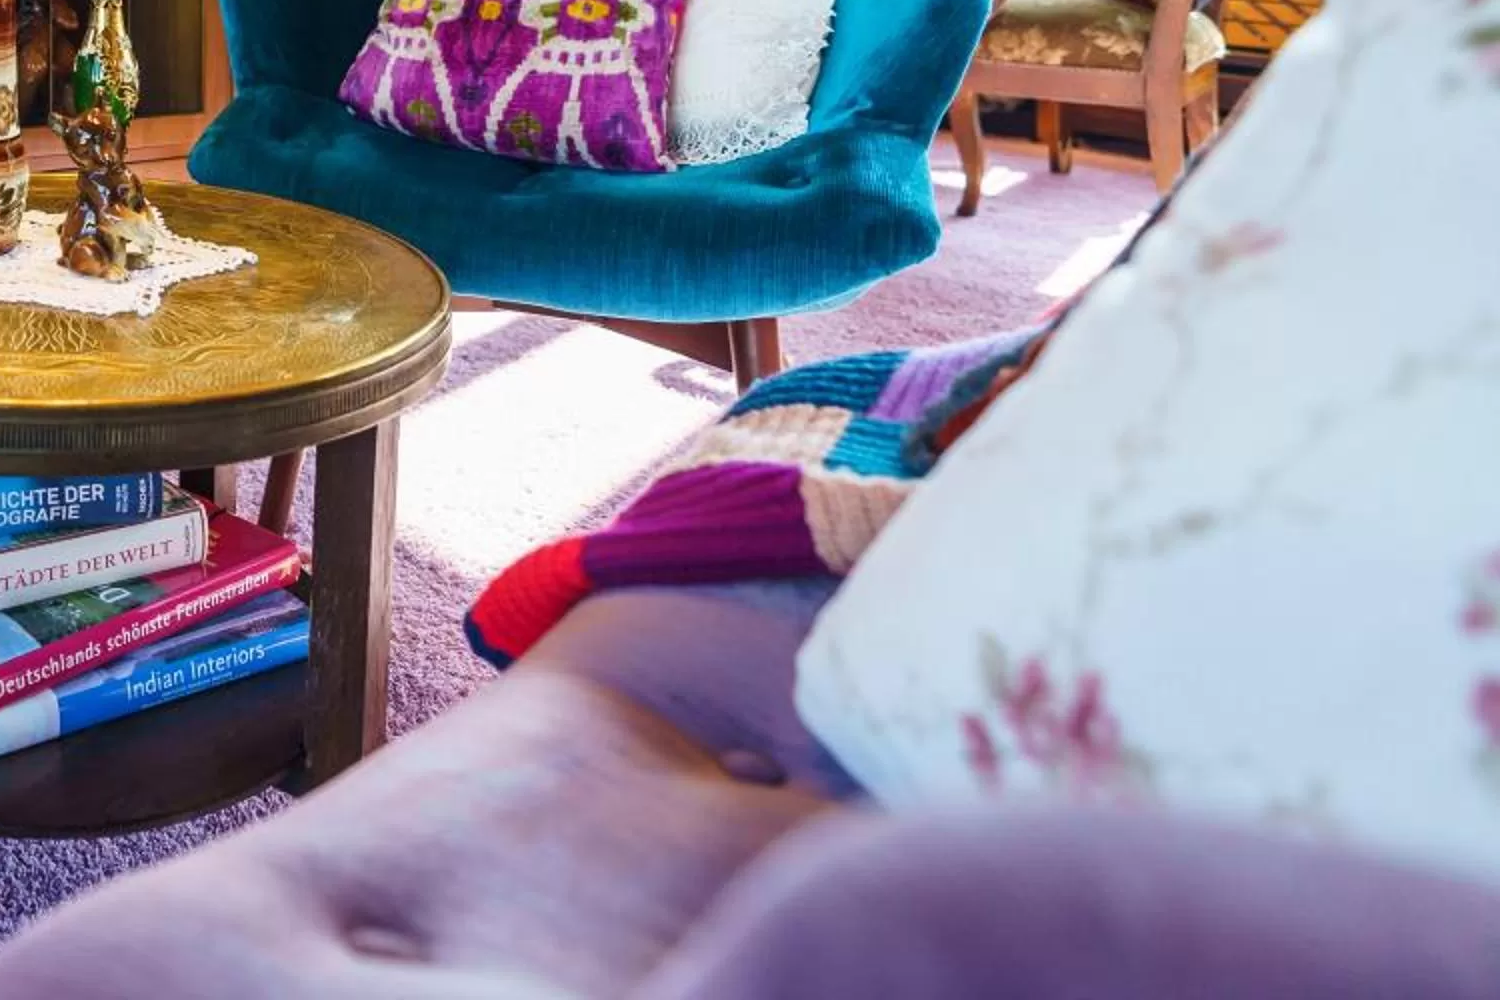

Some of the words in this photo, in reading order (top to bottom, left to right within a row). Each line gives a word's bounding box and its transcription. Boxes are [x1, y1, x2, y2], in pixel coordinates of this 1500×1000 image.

[64, 483, 105, 503] DER
[77, 553, 116, 575] DER
[119, 540, 173, 564] WELT
[107, 610, 171, 651] schönste
[175, 571, 270, 621] Ferienstraßen
[125, 668, 185, 701] Indian
[190, 643, 266, 681] Interiors
